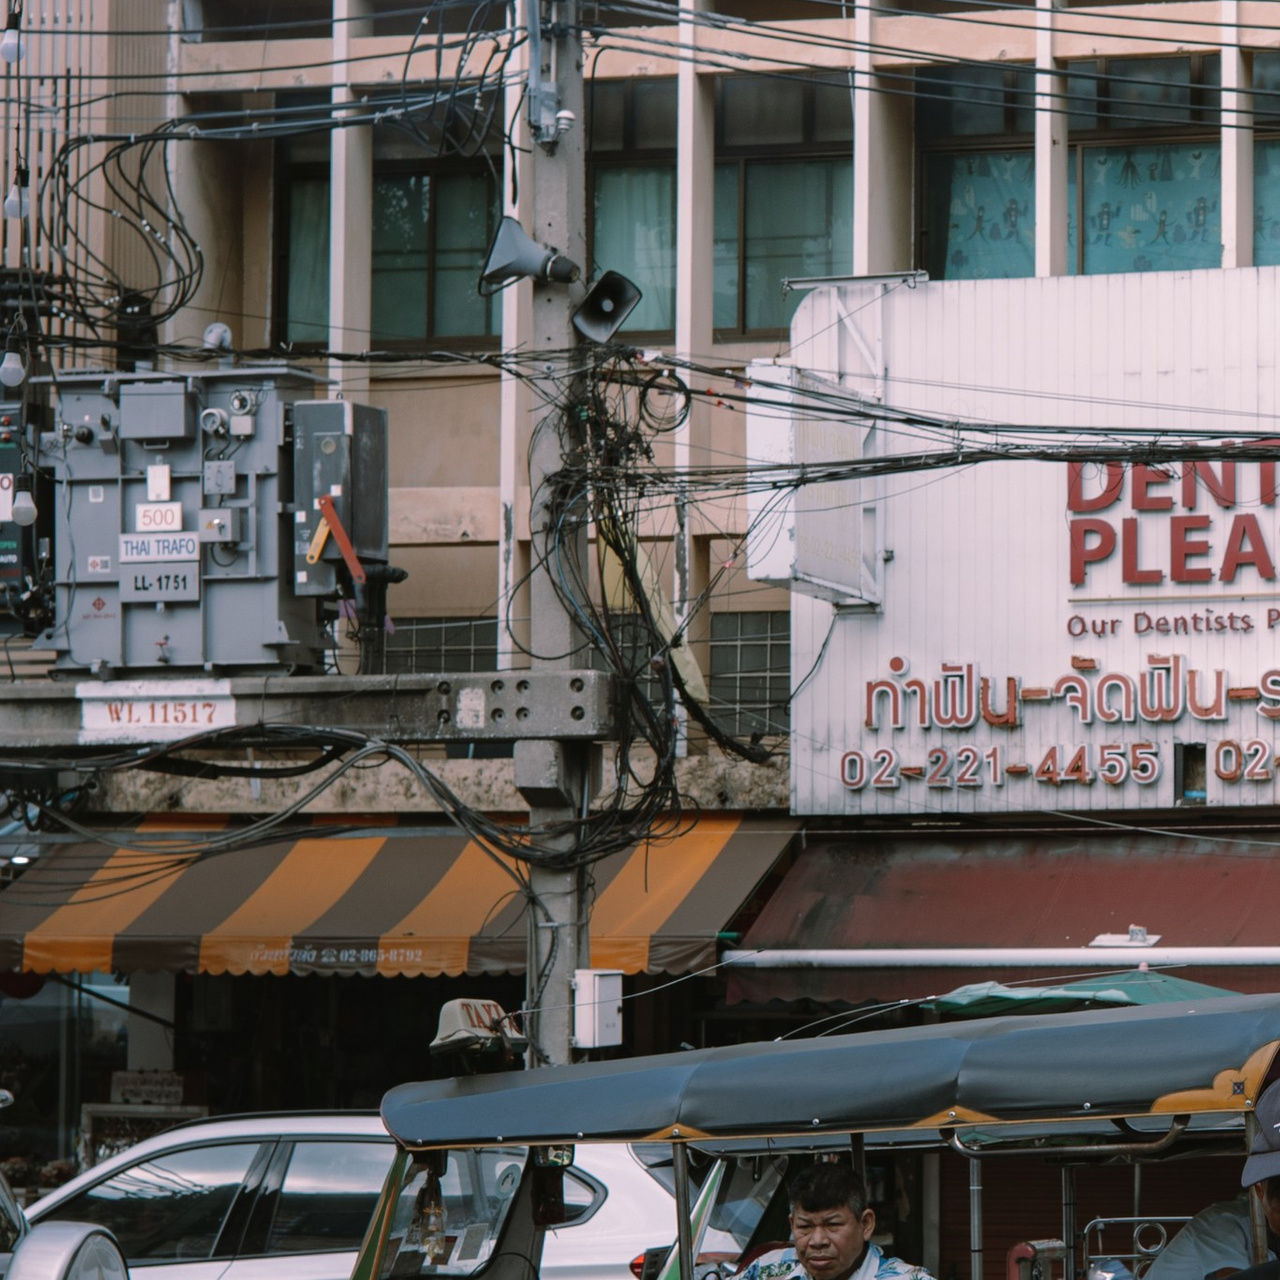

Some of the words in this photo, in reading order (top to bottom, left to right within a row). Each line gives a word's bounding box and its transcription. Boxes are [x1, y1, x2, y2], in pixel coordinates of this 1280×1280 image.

[142, 508, 175, 527] 500
[123, 540, 150, 556] THAI
[155, 538, 196, 555] TRAFO
[1067, 614, 1121, 638] Our
[1133, 608, 1254, 635] Dentists
[149, 700, 217, 725] 11517
[840, 740, 1161, 791] 02-221-4455
